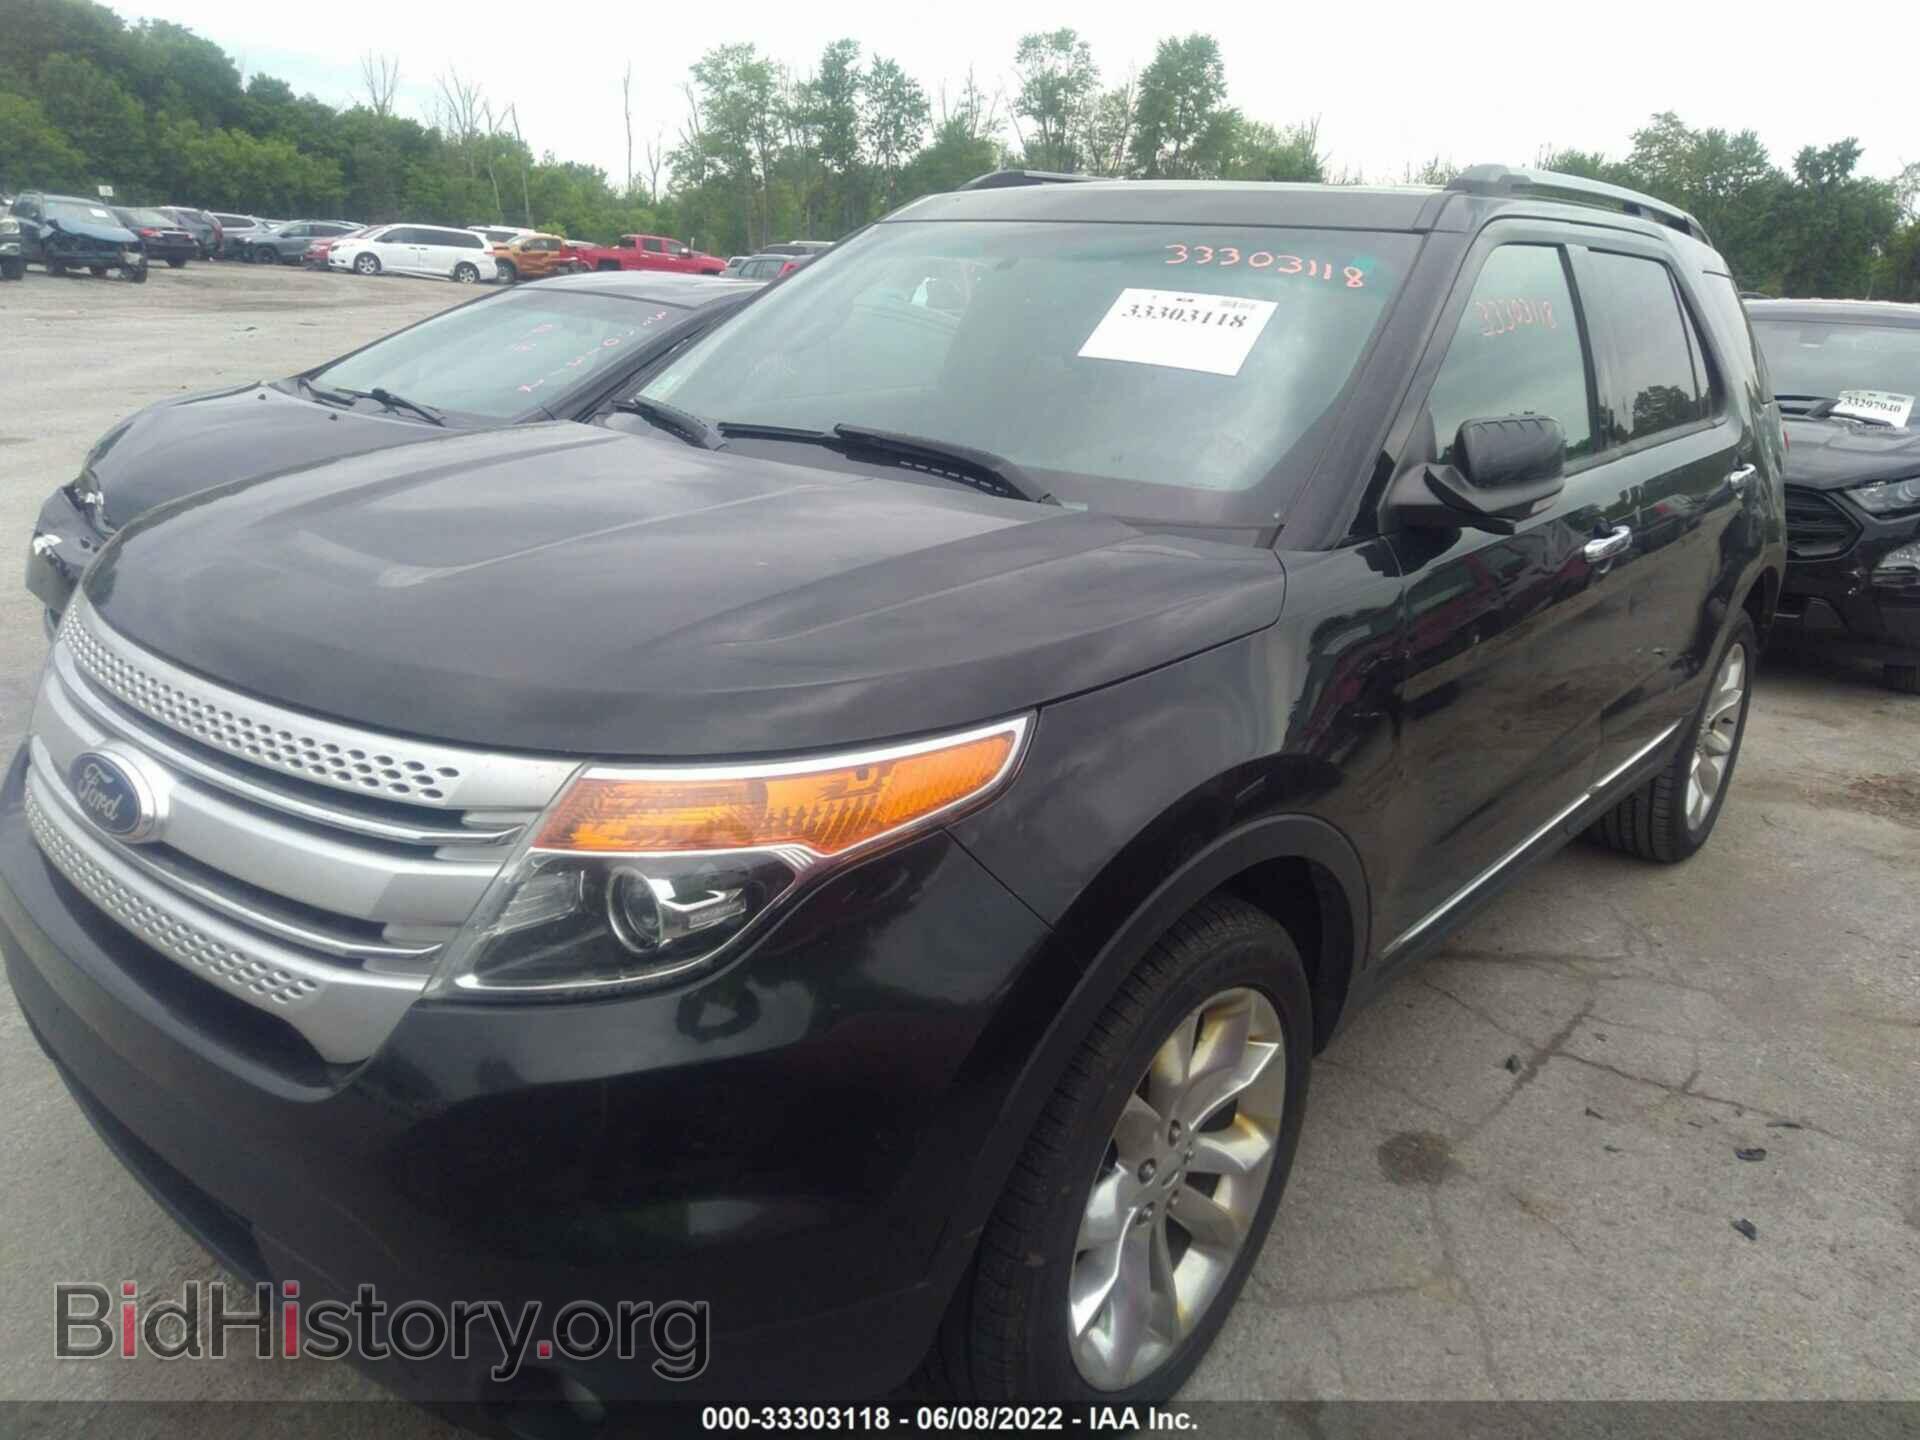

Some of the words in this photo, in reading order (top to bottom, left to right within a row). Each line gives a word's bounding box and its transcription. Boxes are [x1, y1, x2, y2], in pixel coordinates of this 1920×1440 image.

[1164, 243, 1365, 288] 33303118
[1120, 303, 1249, 329] 33303118
[77, 762, 123, 821] Ford
